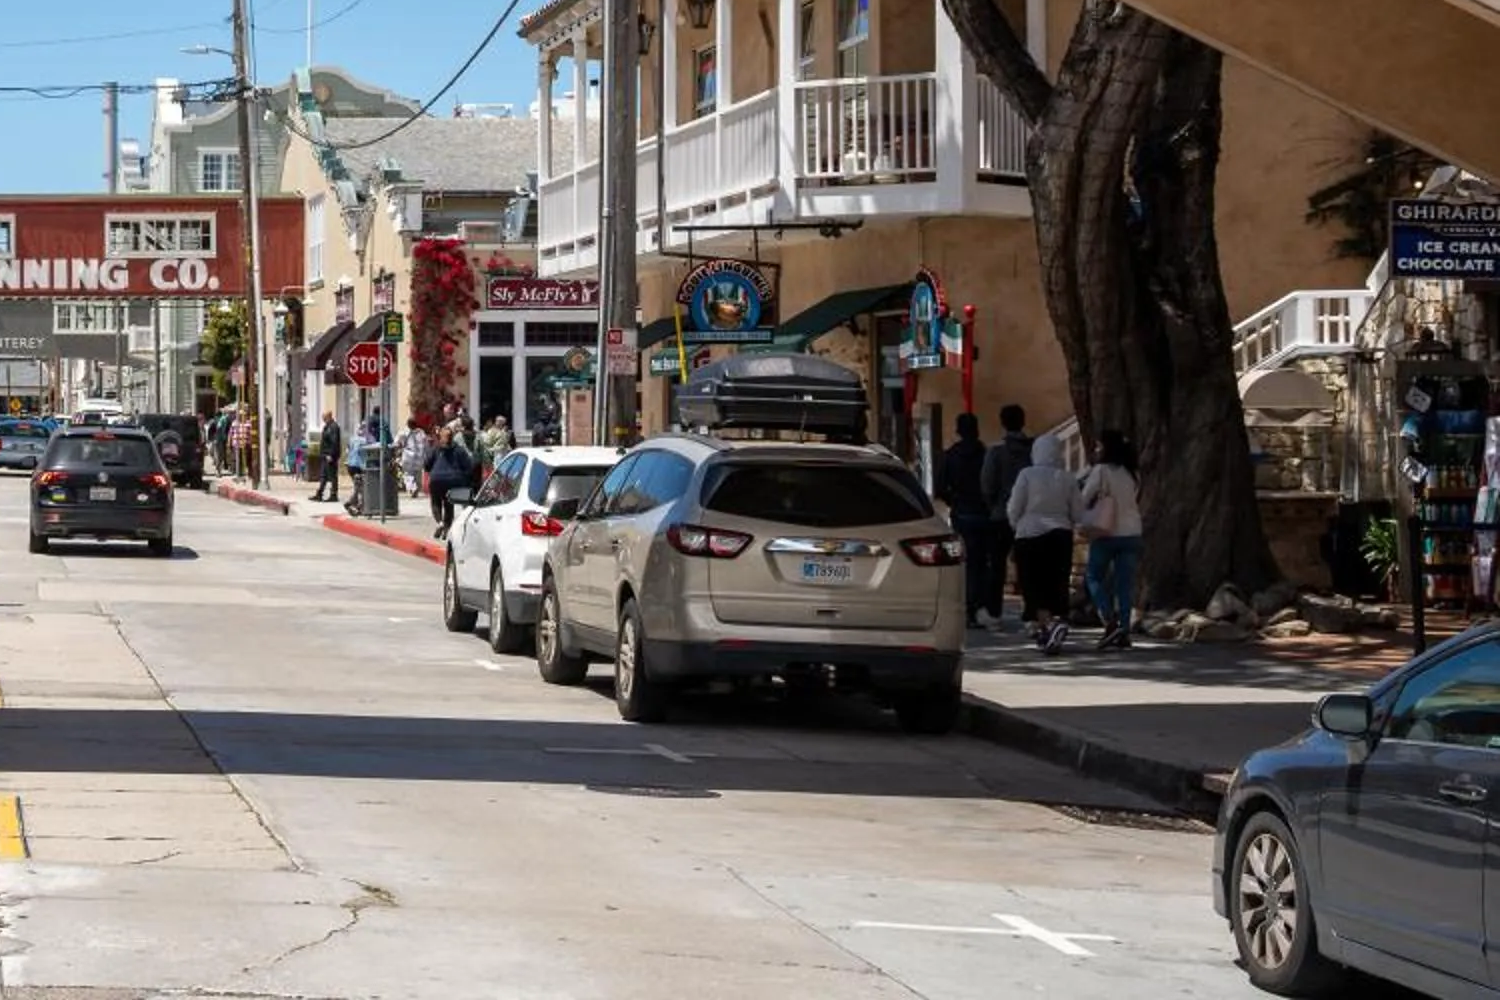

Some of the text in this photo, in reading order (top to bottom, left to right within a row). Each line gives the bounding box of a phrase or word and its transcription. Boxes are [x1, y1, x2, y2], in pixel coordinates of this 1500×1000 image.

[1418, 241, 1444, 253] ICE
[1397, 258, 1495, 271] CHOCOLATE
[149, 258, 220, 291] CO.
[493, 287, 579, 303] Sly McFly's
[349, 356, 389, 374] STOP
